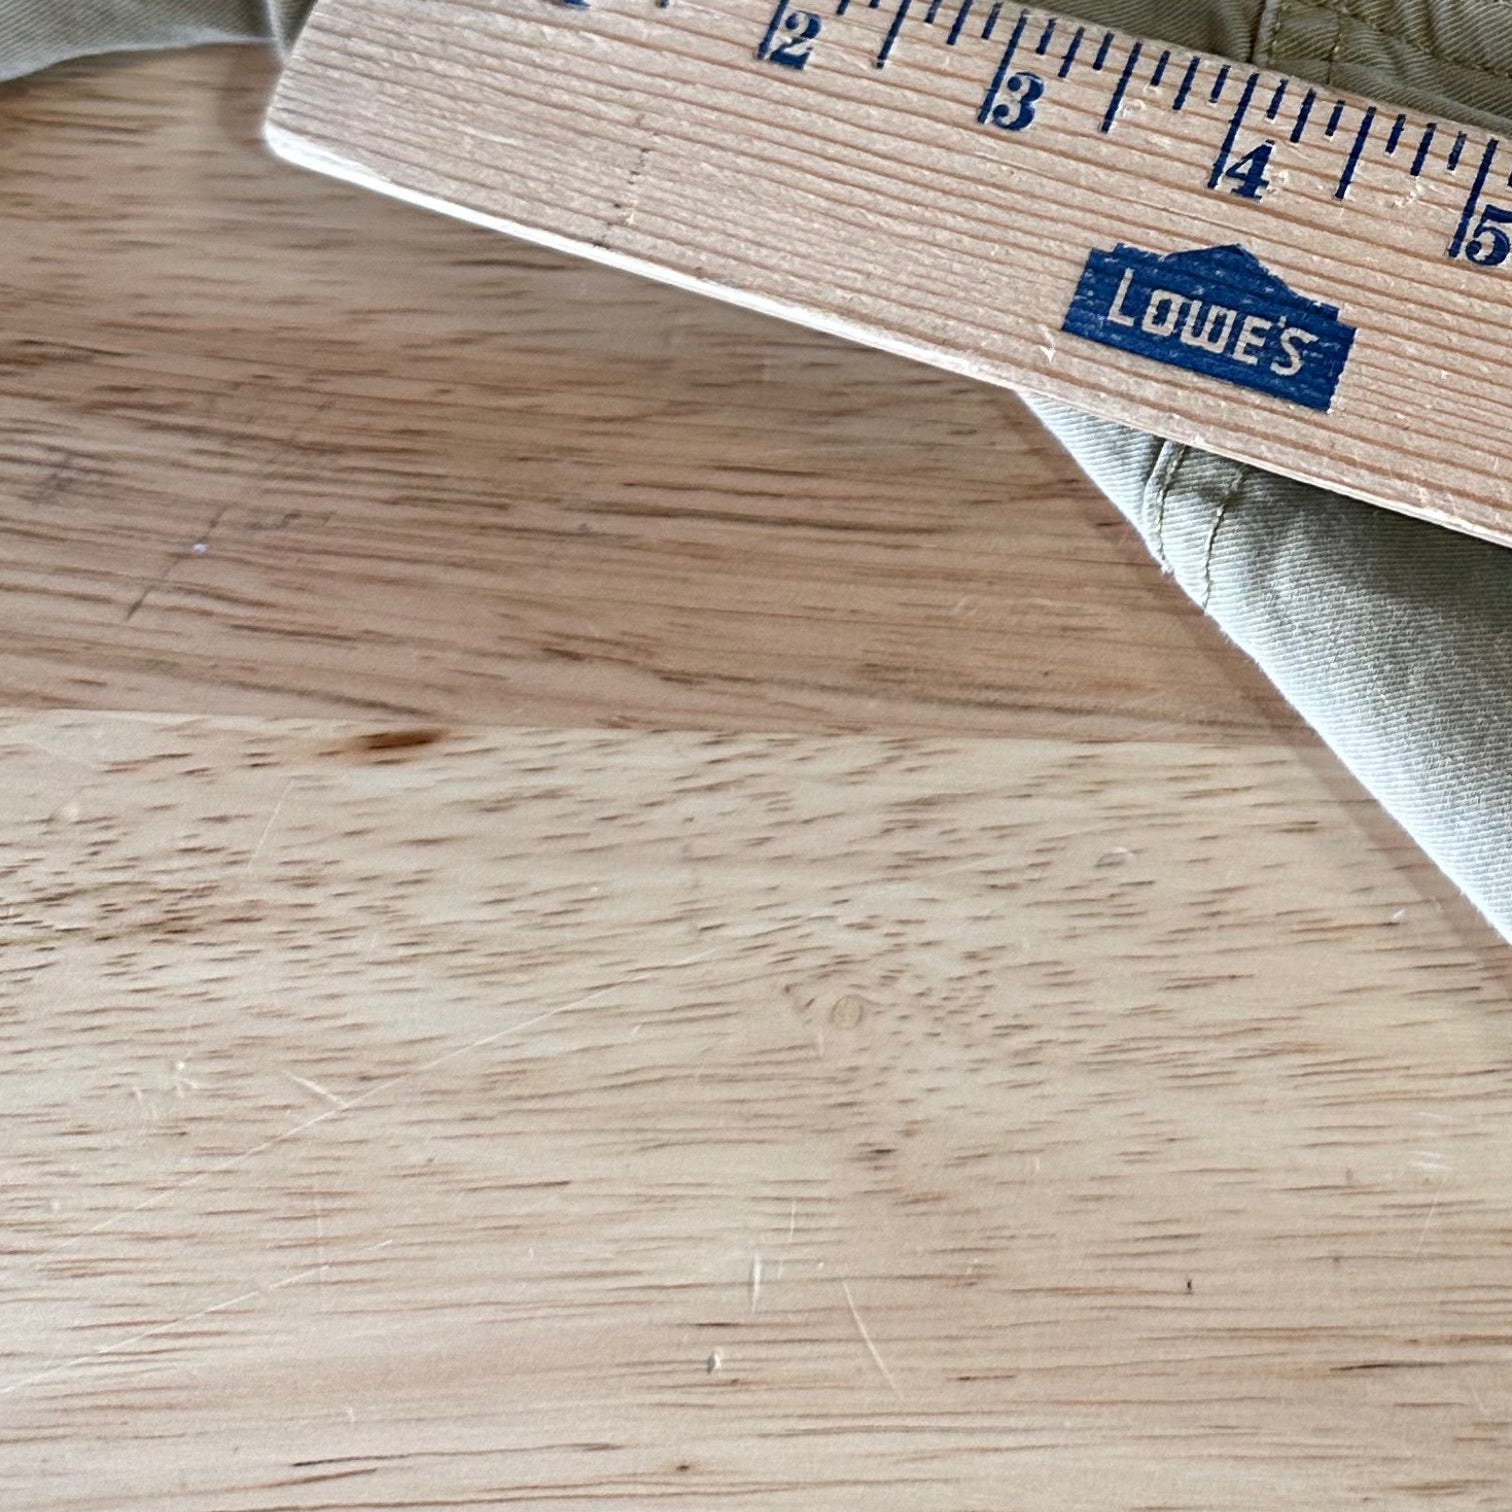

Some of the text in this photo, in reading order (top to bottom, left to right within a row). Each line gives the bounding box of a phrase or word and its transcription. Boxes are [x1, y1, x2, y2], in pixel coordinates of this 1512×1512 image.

[769, 9, 823, 70] 2
[991, 71, 1045, 131] 3
[1225, 139, 1275, 200] 4
[1106, 267, 1319, 377] LOWE'S
